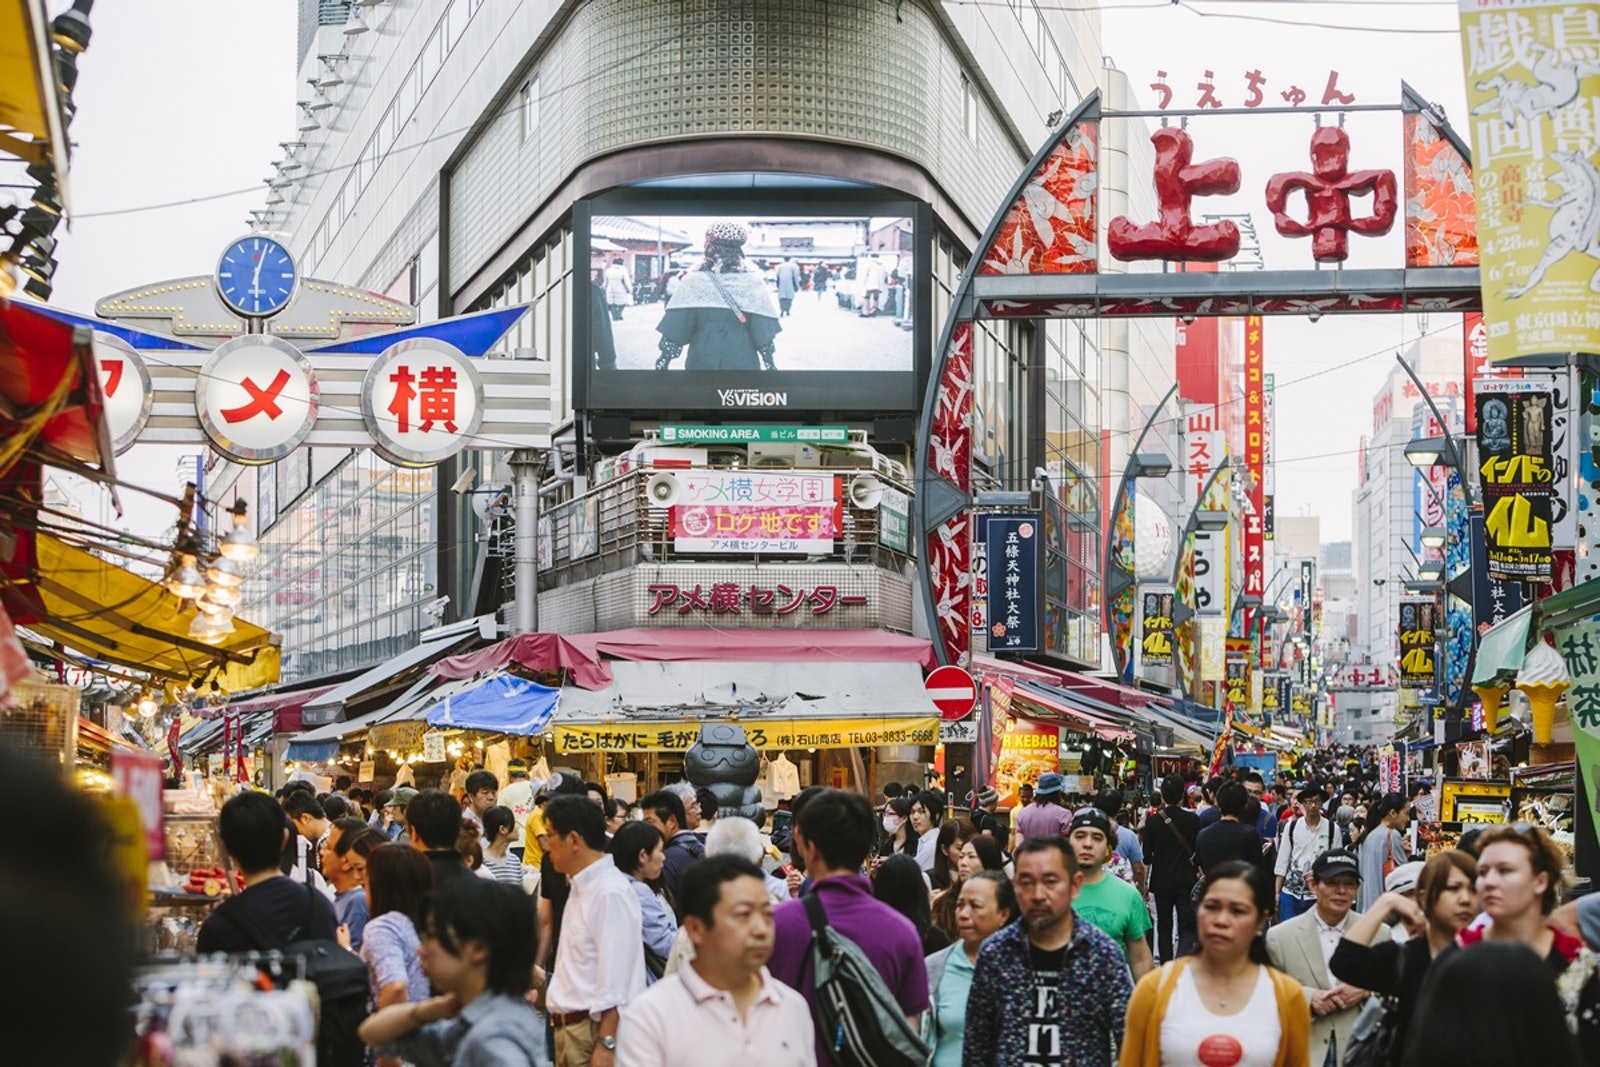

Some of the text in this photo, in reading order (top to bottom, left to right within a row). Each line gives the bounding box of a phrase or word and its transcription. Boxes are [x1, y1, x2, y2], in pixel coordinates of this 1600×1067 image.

[1150, 69, 1356, 109] うえちゅん
[678, 429, 727, 439] SMOKING
[730, 430, 760, 439] AREA
[1480, 455, 1551, 484] インドの
[686, 477, 824, 502] アメ横女学園
[715, 511, 825, 533] ロケ地です
[1486, 492, 1550, 547] 仏
[710, 539, 799, 551] アメ横センタービル
[1005, 532, 1021, 629] 五條天神社大祭
[649, 582, 867, 614] アメ横センター
[563, 731, 648, 750] たらばがに
[657, 731, 699, 748] 毛が
[776, 732, 841, 746] (株)石山商店
[1016, 734, 1057, 748] KEBAB
